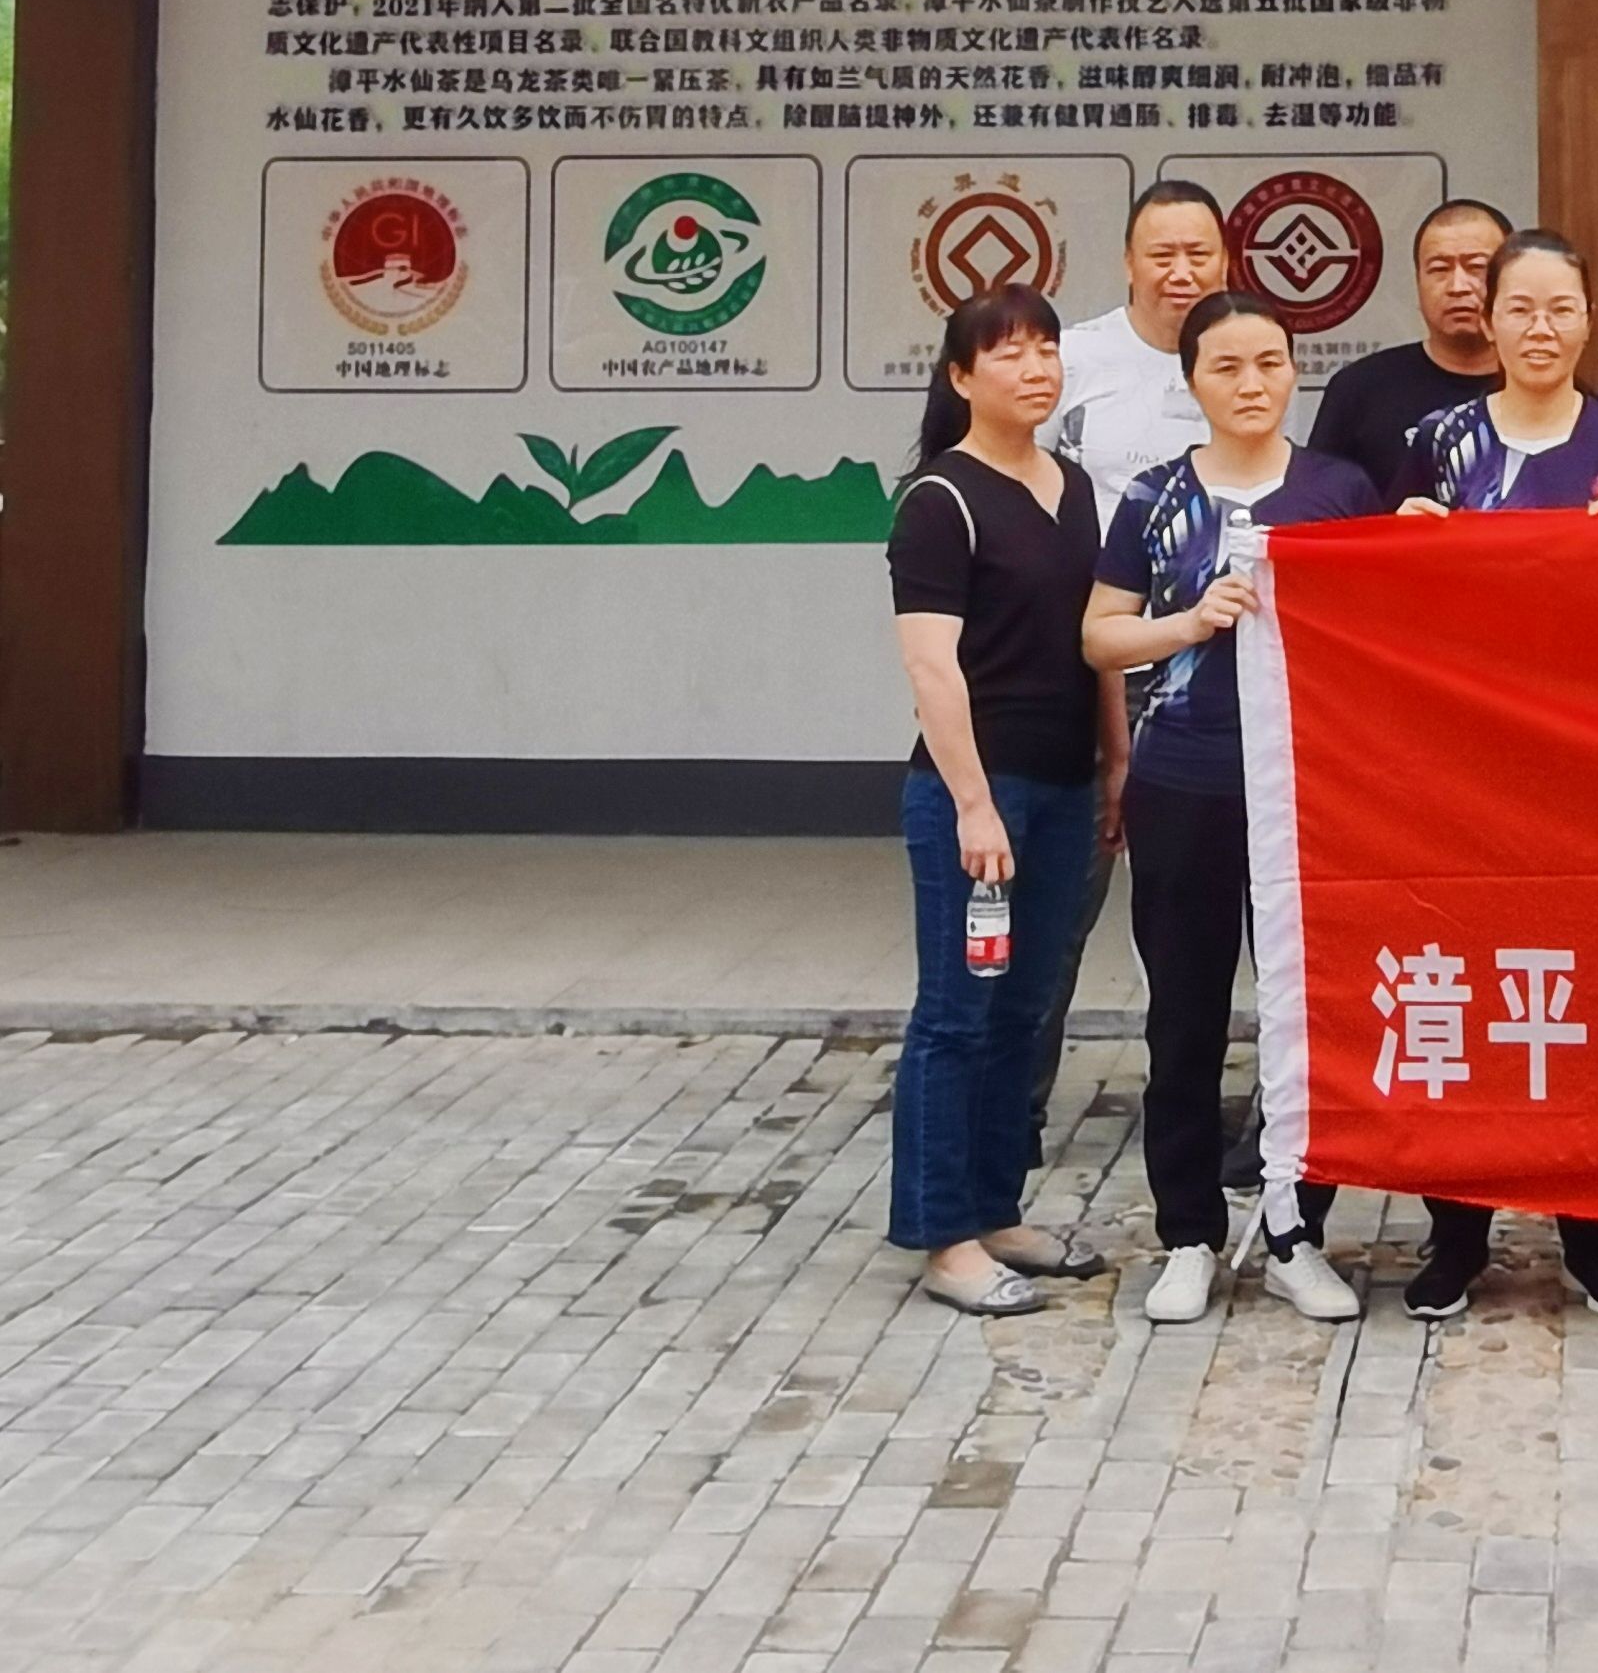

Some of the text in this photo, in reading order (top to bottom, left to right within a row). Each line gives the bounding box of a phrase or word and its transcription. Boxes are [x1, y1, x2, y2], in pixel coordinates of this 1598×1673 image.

[371, 213, 420, 248] GI
[641, 339, 728, 355] AG100147
[335, 359, 451, 378] 中国地理标志
[602, 358, 768, 377] 中国农产品地理标志
